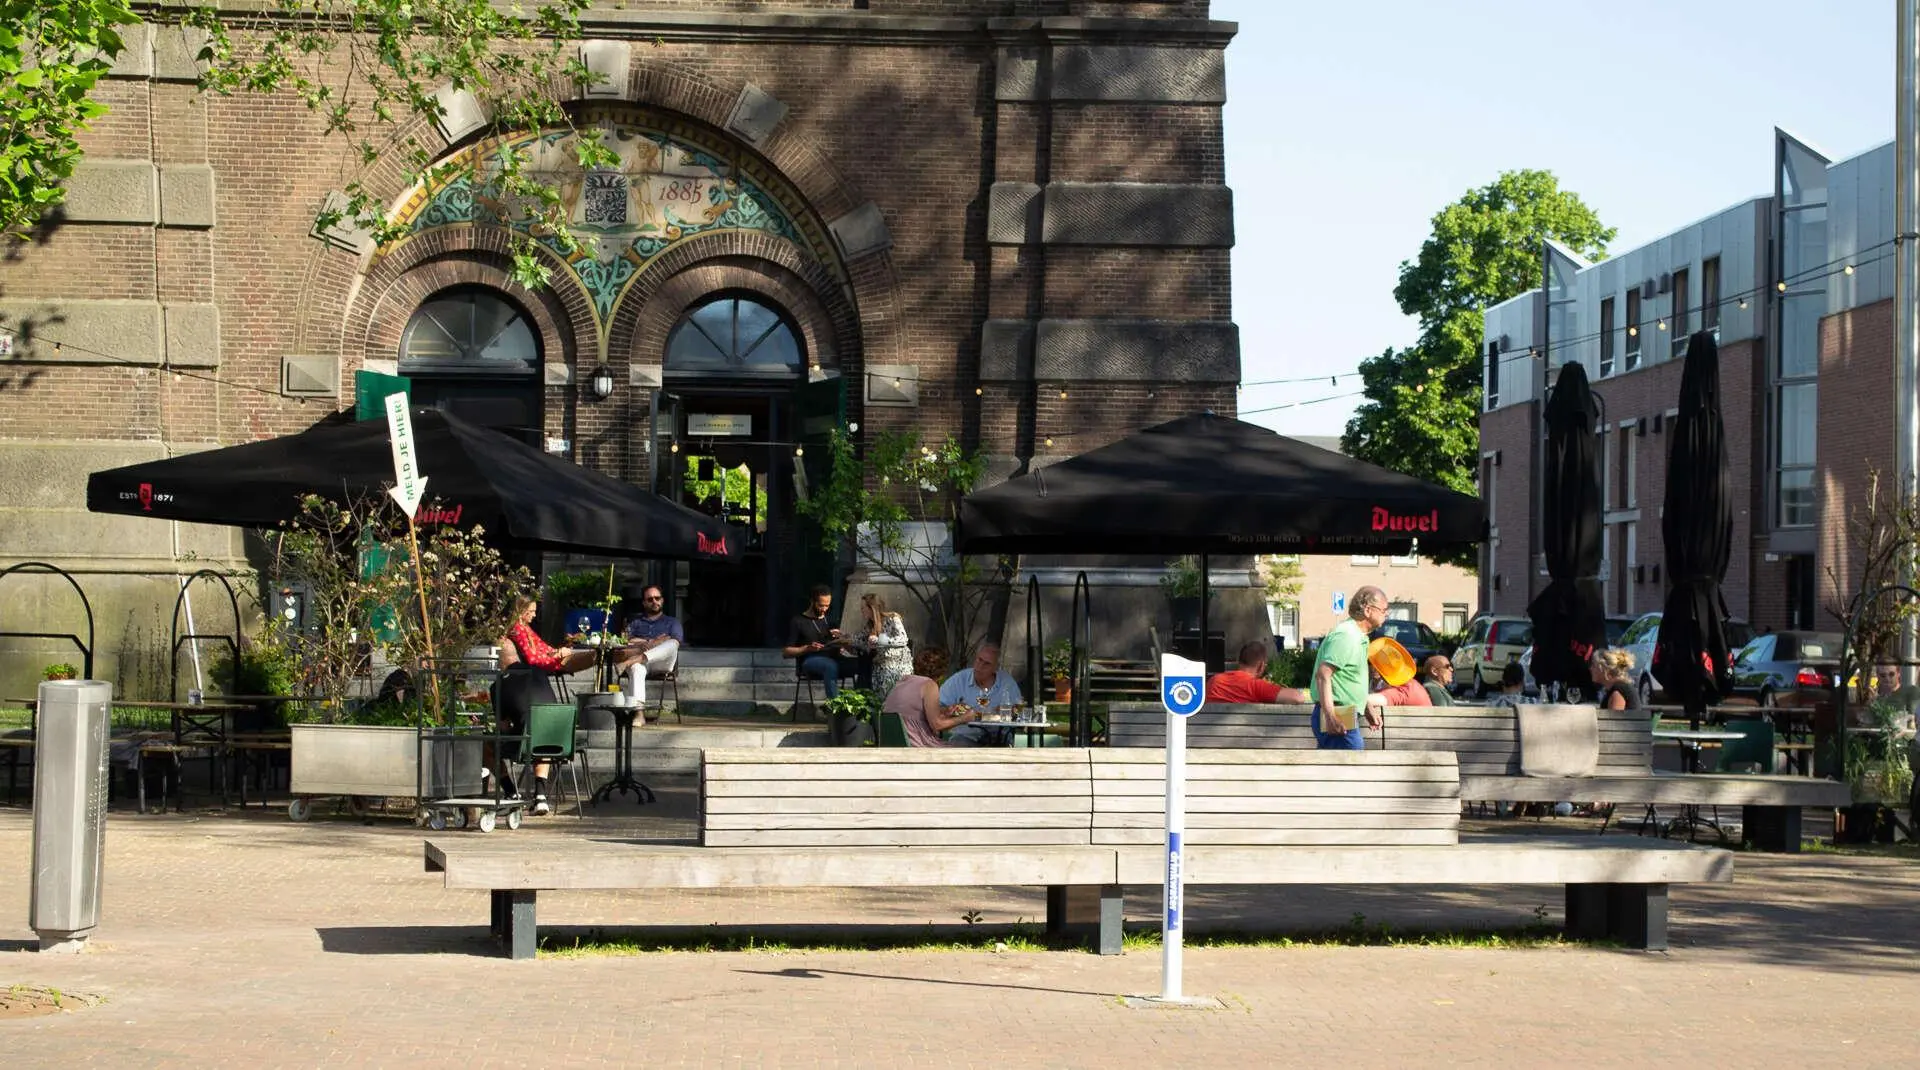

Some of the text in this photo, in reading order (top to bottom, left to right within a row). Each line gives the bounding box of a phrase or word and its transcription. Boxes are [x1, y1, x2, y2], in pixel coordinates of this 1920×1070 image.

[659, 181, 703, 204] 1885
[400, 441, 408, 457] JE
[403, 463, 414, 500] MELD
[153, 494, 173, 502] 1871
[1371, 505, 1438, 532] Duvel
[696, 531, 728, 555] Duvel
